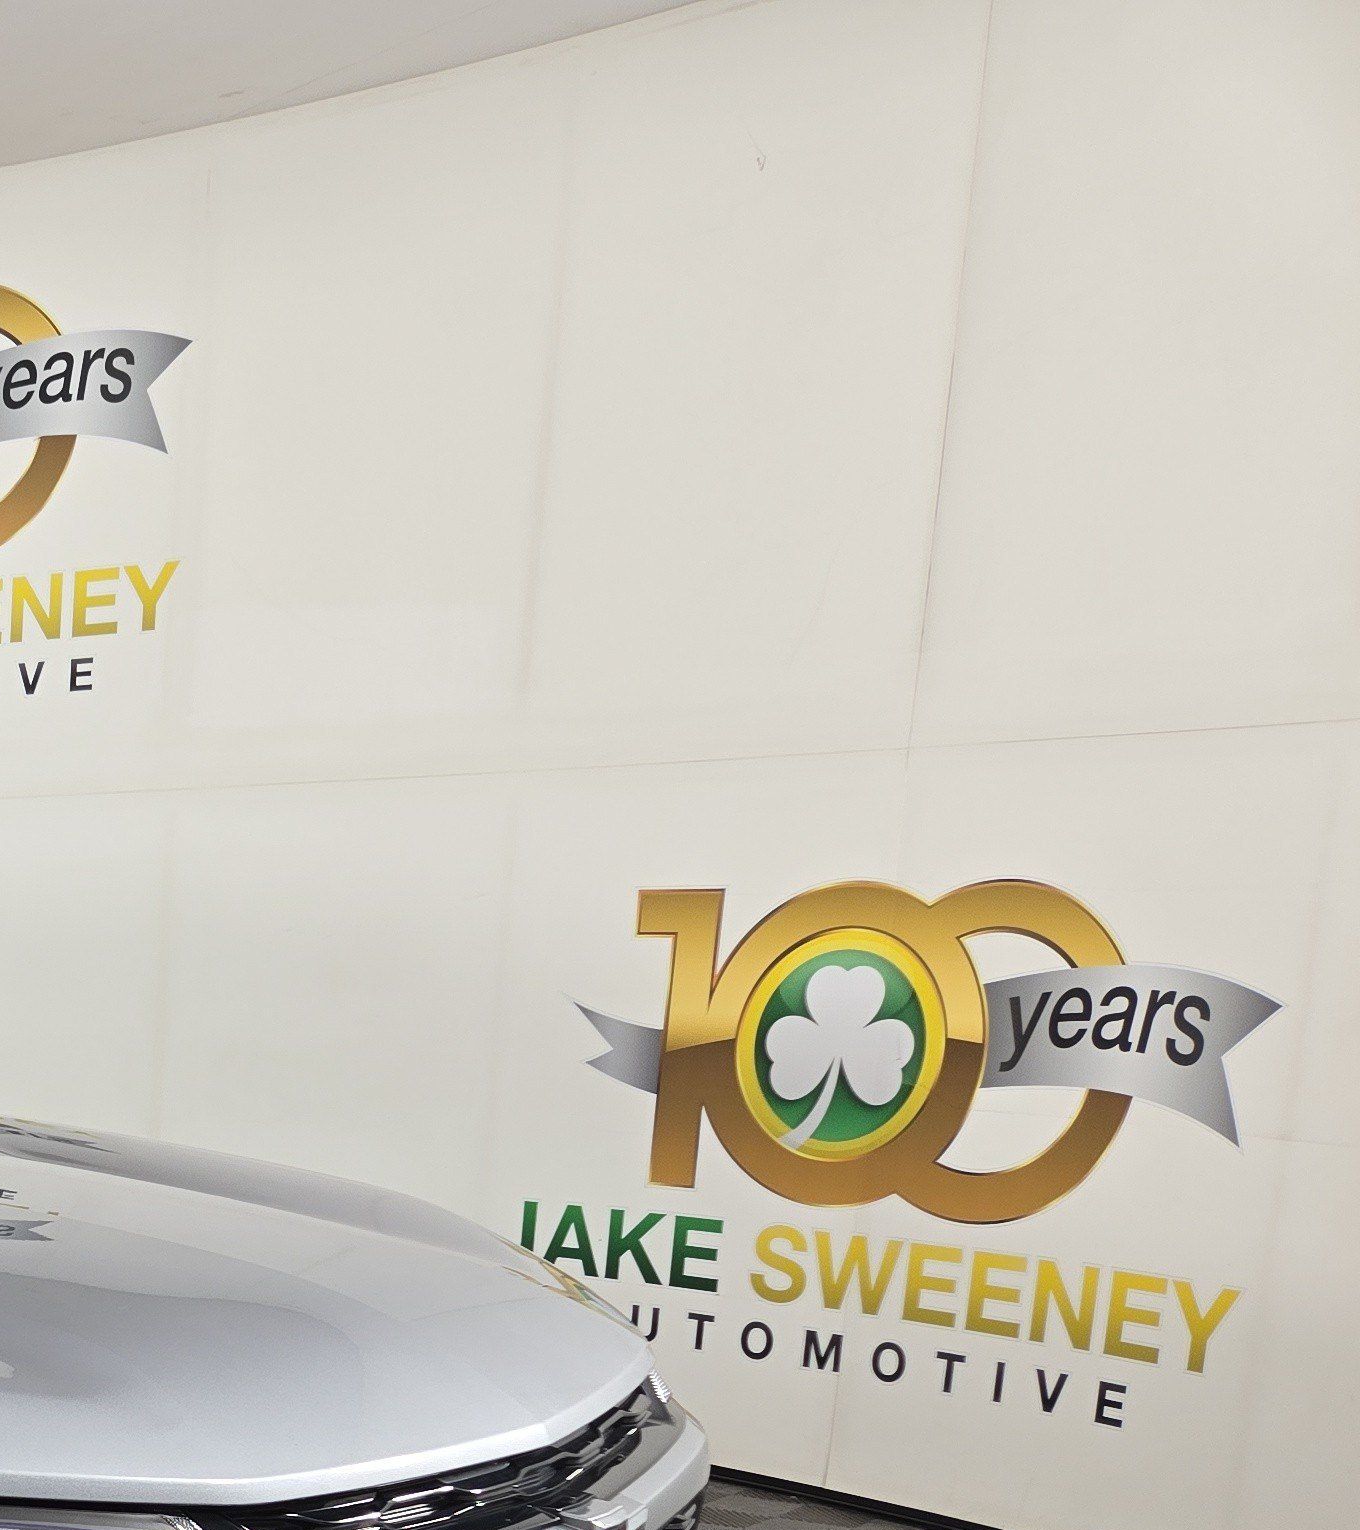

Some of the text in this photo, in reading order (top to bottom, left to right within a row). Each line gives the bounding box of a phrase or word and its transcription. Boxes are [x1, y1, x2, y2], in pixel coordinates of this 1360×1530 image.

[636, 878, 1212, 1225] 100 years
[630, 1303, 1129, 1430] UTOMOTIVE
[749, 1224, 1242, 1375] SWEENEY
